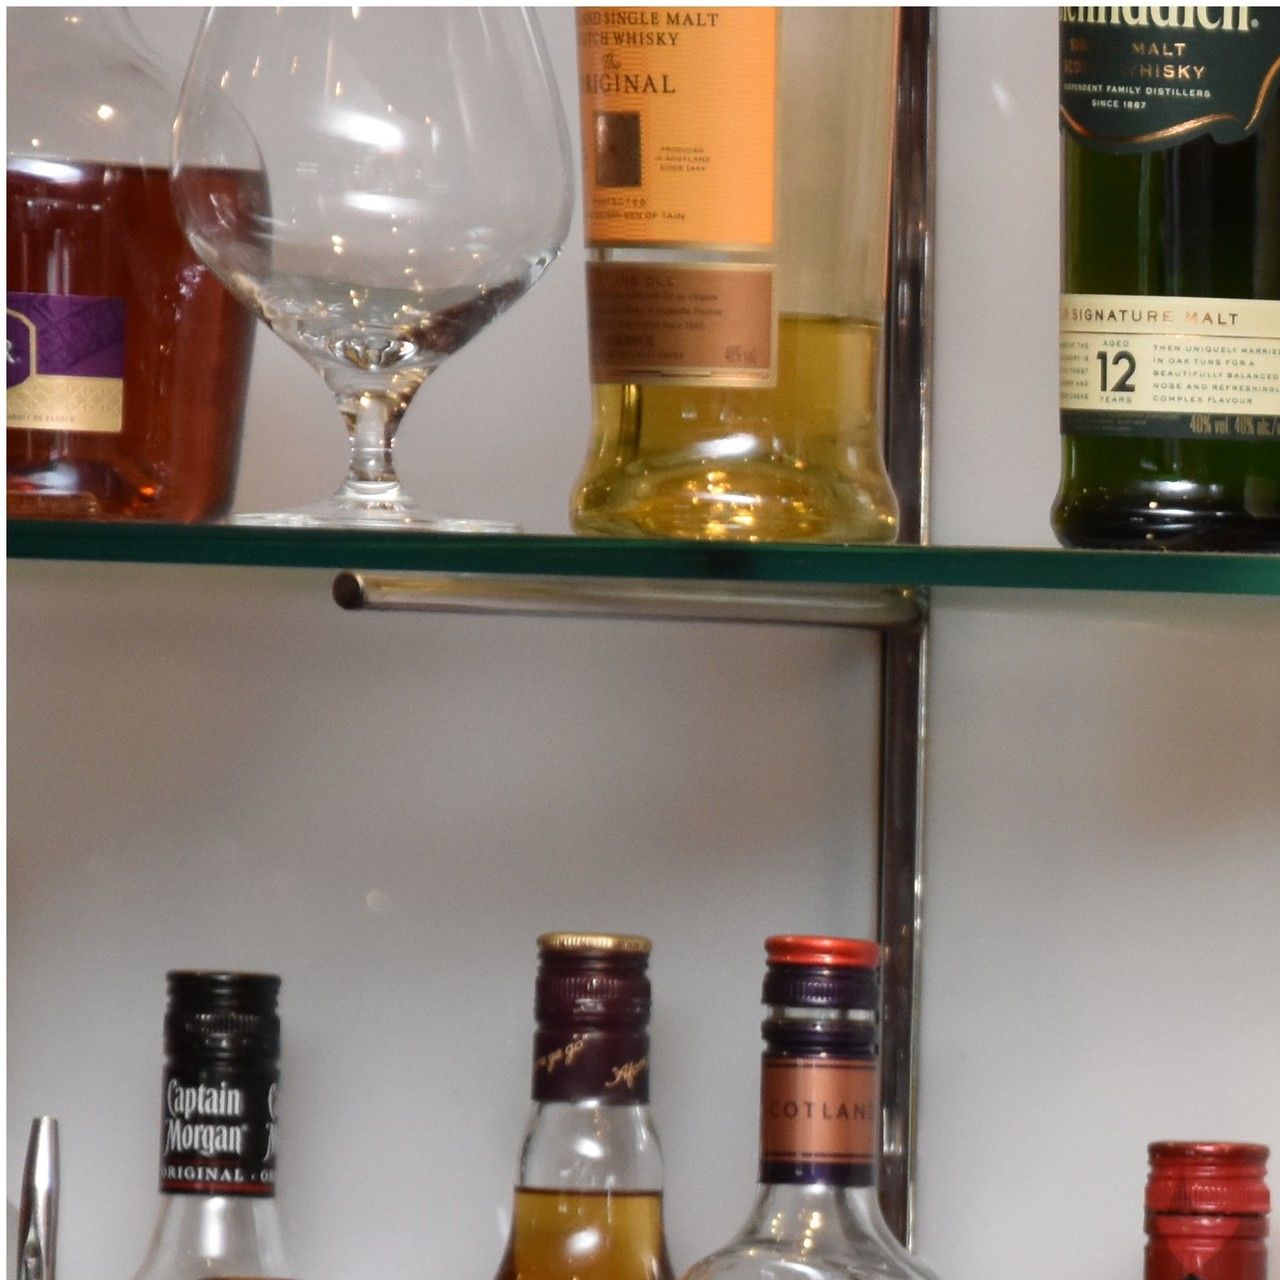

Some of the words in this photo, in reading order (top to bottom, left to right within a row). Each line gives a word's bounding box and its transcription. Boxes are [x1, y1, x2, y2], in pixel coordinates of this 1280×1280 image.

[666, 13, 719, 28] MALT
[613, 31, 679, 47] WHISKY
[1131, 42, 1186, 56] MALT
[1106, 84, 1141, 95] FAMILY
[1145, 86, 1211, 98] DISTILLERS
[1092, 98, 1119, 107] SINCE
[1071, 308, 1174, 324] SIGNATURE
[1185, 310, 1239, 326] MALT
[1096, 350, 1138, 392] 12
[167, 1078, 243, 1120] Captain
[767, 1101, 873, 1121] COTLAN
[163, 1119, 242, 1157] Morgan
